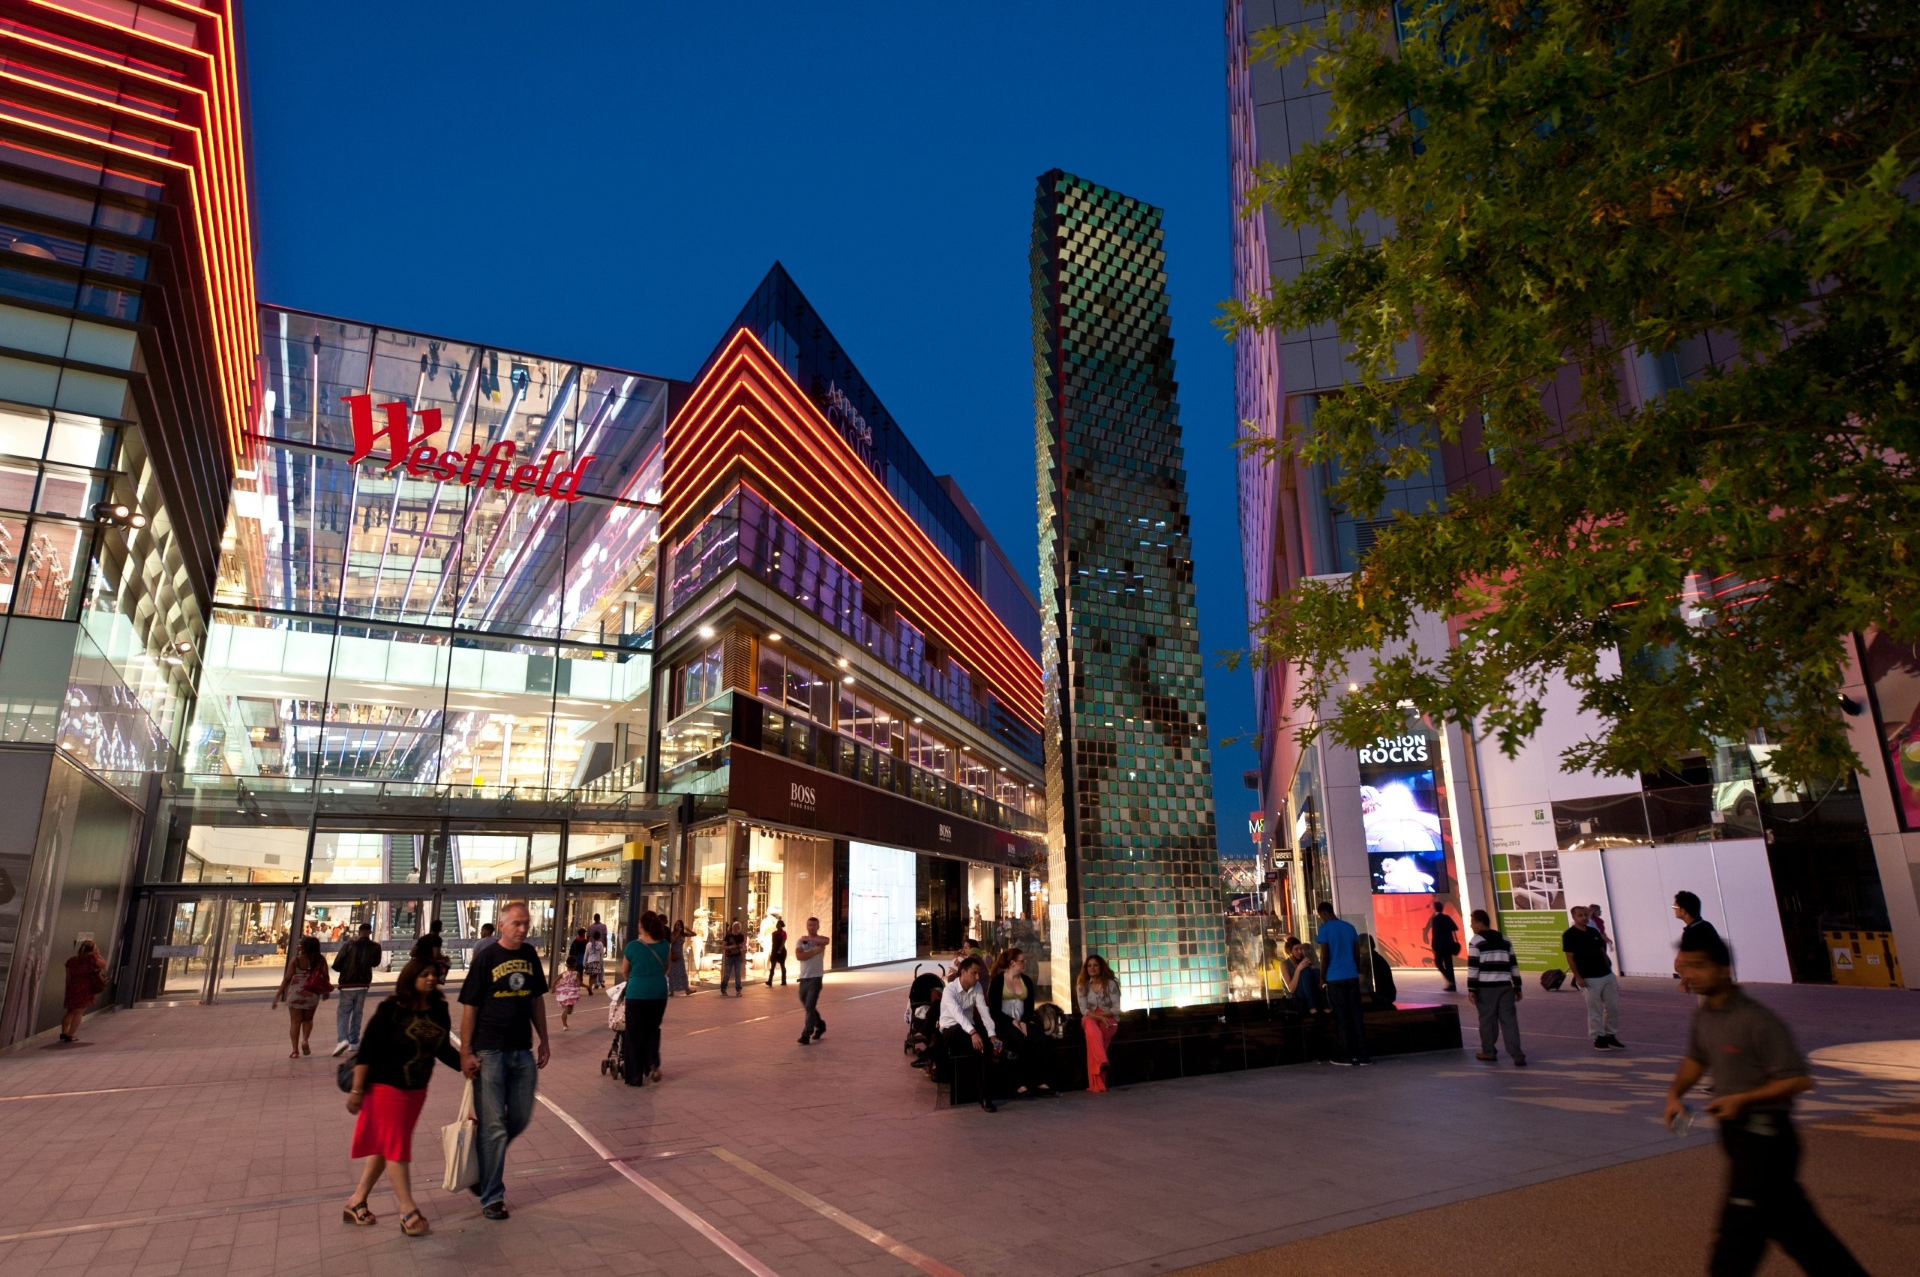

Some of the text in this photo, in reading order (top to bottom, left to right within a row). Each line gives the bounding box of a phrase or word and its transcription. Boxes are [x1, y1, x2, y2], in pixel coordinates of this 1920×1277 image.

[829, 379, 872, 446] ASPERS
[340, 394, 597, 503] Westfield
[1359, 746, 1428, 764] ROCKS
[791, 782, 816, 805] BOSS
[939, 823, 952, 839] BOSS
